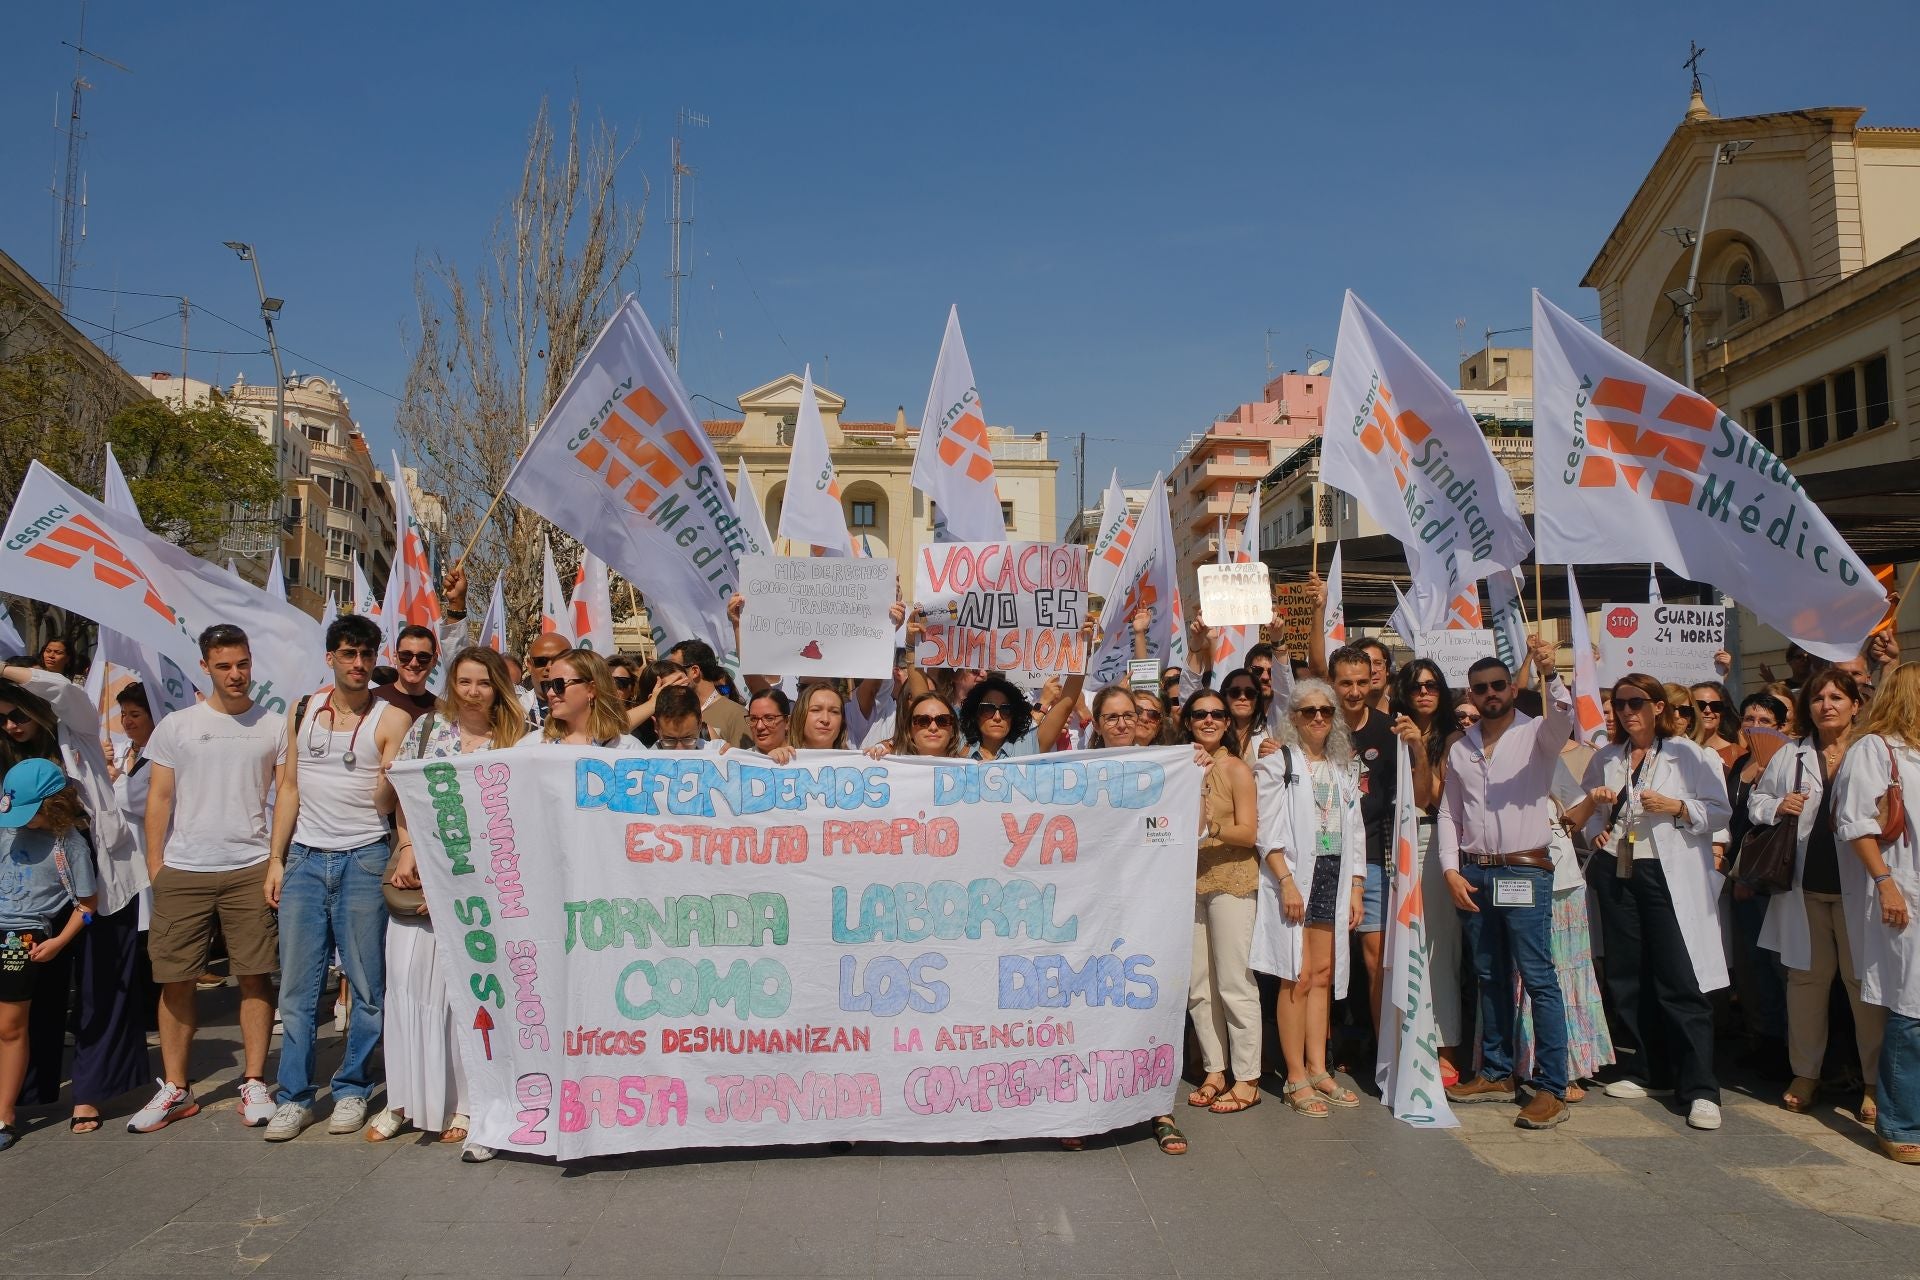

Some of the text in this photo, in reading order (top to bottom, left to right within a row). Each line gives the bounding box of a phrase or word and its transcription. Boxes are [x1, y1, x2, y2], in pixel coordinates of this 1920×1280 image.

[567, 376, 633, 452] cesmcv
[1563, 373, 1593, 485] cesmcv
[1411, 438, 1496, 562] Sindicato
[6, 504, 70, 551] cesmcv
[1094, 507, 1128, 557] cesmcv
[1696, 473, 1859, 587] Médico
[749, 579, 868, 600] COMO CUALQUIER
[775, 560, 889, 582] MIS DERECHOS
[923, 544, 1088, 594] VOCACIÓN
[1290, 585, 1302, 594] NO
[957, 589, 1078, 632] NO ES
[1278, 595, 1311, 605] PEDIMO
[1285, 617, 1312, 626] MENO
[1611, 616, 1637, 627] STOP
[1654, 607, 1724, 627] GUARDIAS
[750, 615, 770, 632] NO
[774, 617, 812, 636] COMO
[816, 621, 839, 636] LOS
[921, 624, 1084, 674] SUMISIÓN
[1655, 628, 1722, 643] 24 HORAS
[576, 758, 1165, 817] DEFENDEMOS DIGNIDAD
[625, 823, 807, 865] ESTATUTO
[1000, 812, 1078, 868] YA
[832, 877, 1078, 943] LABORAL
[505, 940, 549, 1052] SOMOS
[614, 938, 1158, 1021] COMO LOS DEMÁS
[893, 1028, 924, 1052] LA
[508, 1072, 553, 1146] NO
[558, 1075, 688, 1132] BASTA
[704, 1071, 882, 1123] JORNADA
